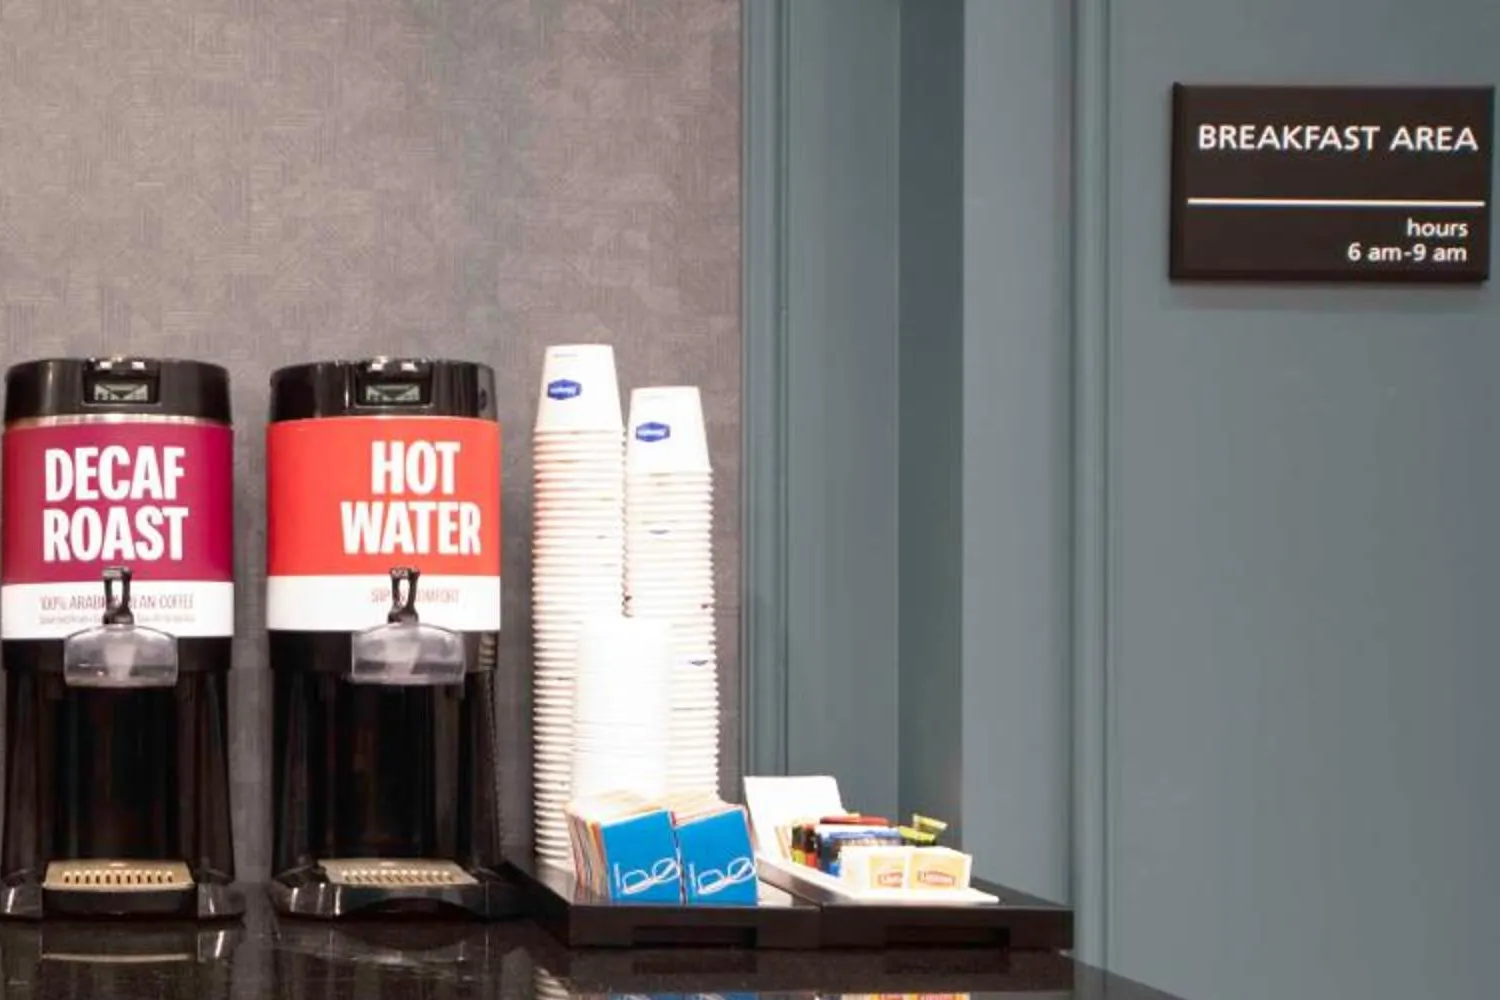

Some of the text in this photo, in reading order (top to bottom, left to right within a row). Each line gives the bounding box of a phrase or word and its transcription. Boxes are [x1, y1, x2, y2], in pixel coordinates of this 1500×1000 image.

[1198, 124, 1479, 151] BREAKFAST AREA
[1406, 218, 1468, 237] hours
[1347, 242, 1361, 261] 6
[1432, 246, 1467, 262] am
[44, 445, 186, 502] DECAF
[371, 440, 461, 495] HOT
[43, 505, 189, 562] ROAST
[340, 501, 482, 556] WATER
[158, 592, 194, 609] COFFEE
